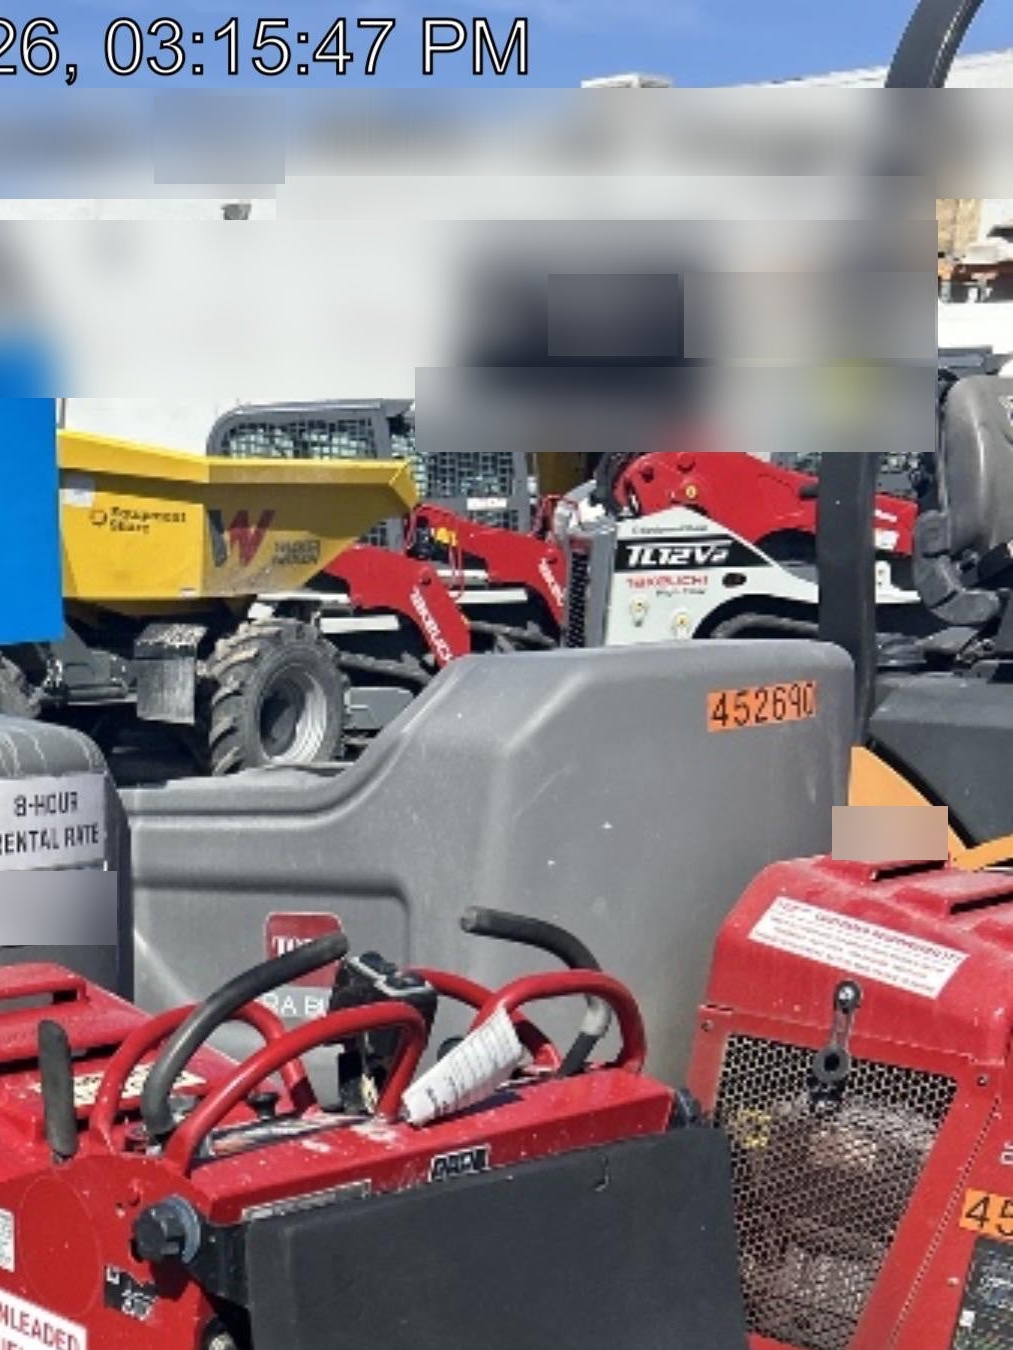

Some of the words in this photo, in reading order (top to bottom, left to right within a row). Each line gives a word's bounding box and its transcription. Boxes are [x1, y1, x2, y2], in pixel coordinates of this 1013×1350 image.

[711, 682, 815, 727] 452690
[13, 791, 79, 817] 8-HOUR
[63, 822, 100, 849] RATE
